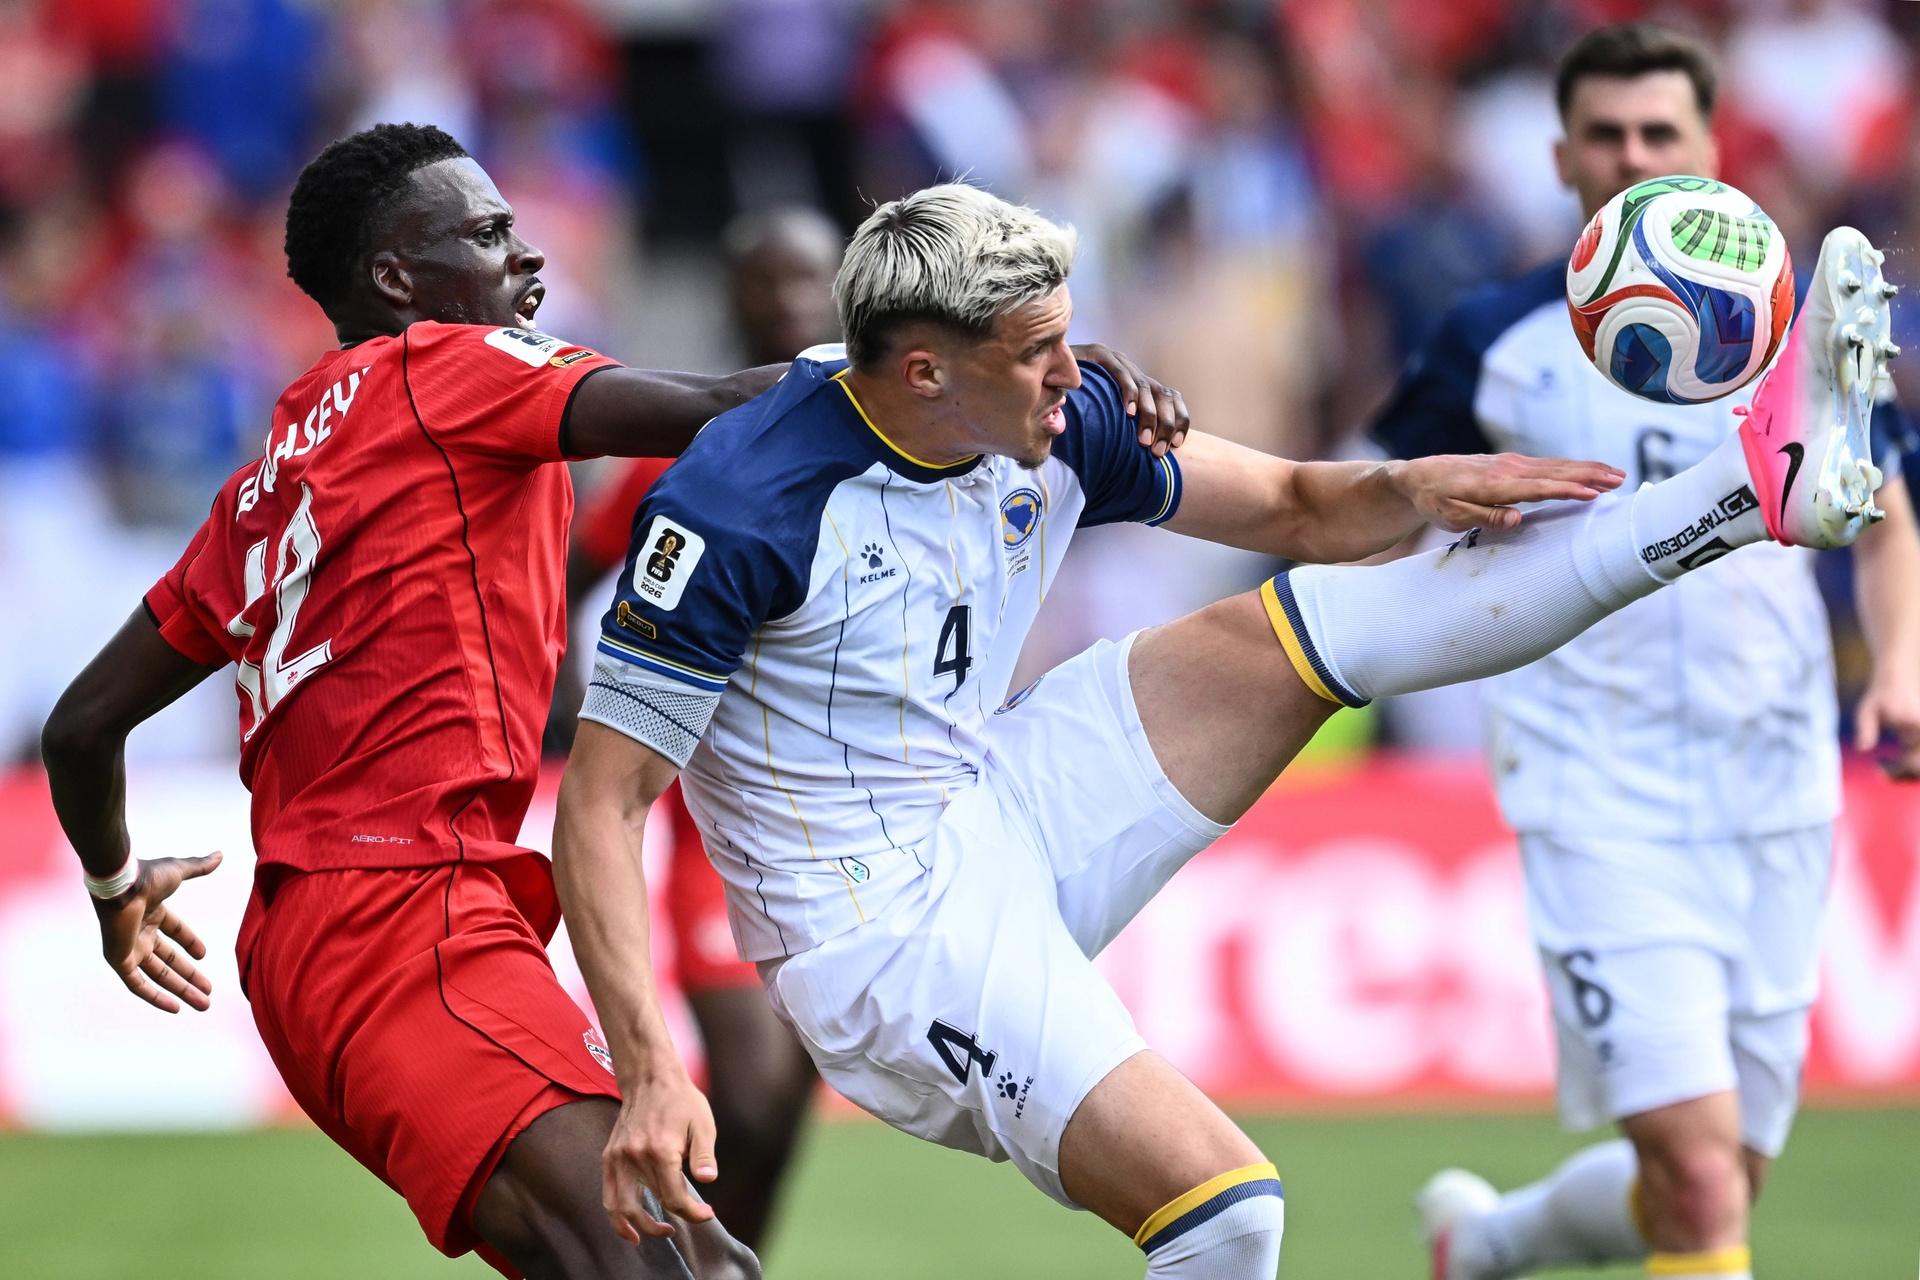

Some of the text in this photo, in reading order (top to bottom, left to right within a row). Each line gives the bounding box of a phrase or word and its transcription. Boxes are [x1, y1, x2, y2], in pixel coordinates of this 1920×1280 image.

[640, 581, 663, 599] 2026
[860, 568, 896, 585] KELME
[933, 604, 973, 702] 4
[351, 834, 414, 845] AERO-FIT
[1560, 949, 1612, 1029] 6
[926, 1017, 998, 1086] 4
[1014, 1075, 1034, 1120] KELME
